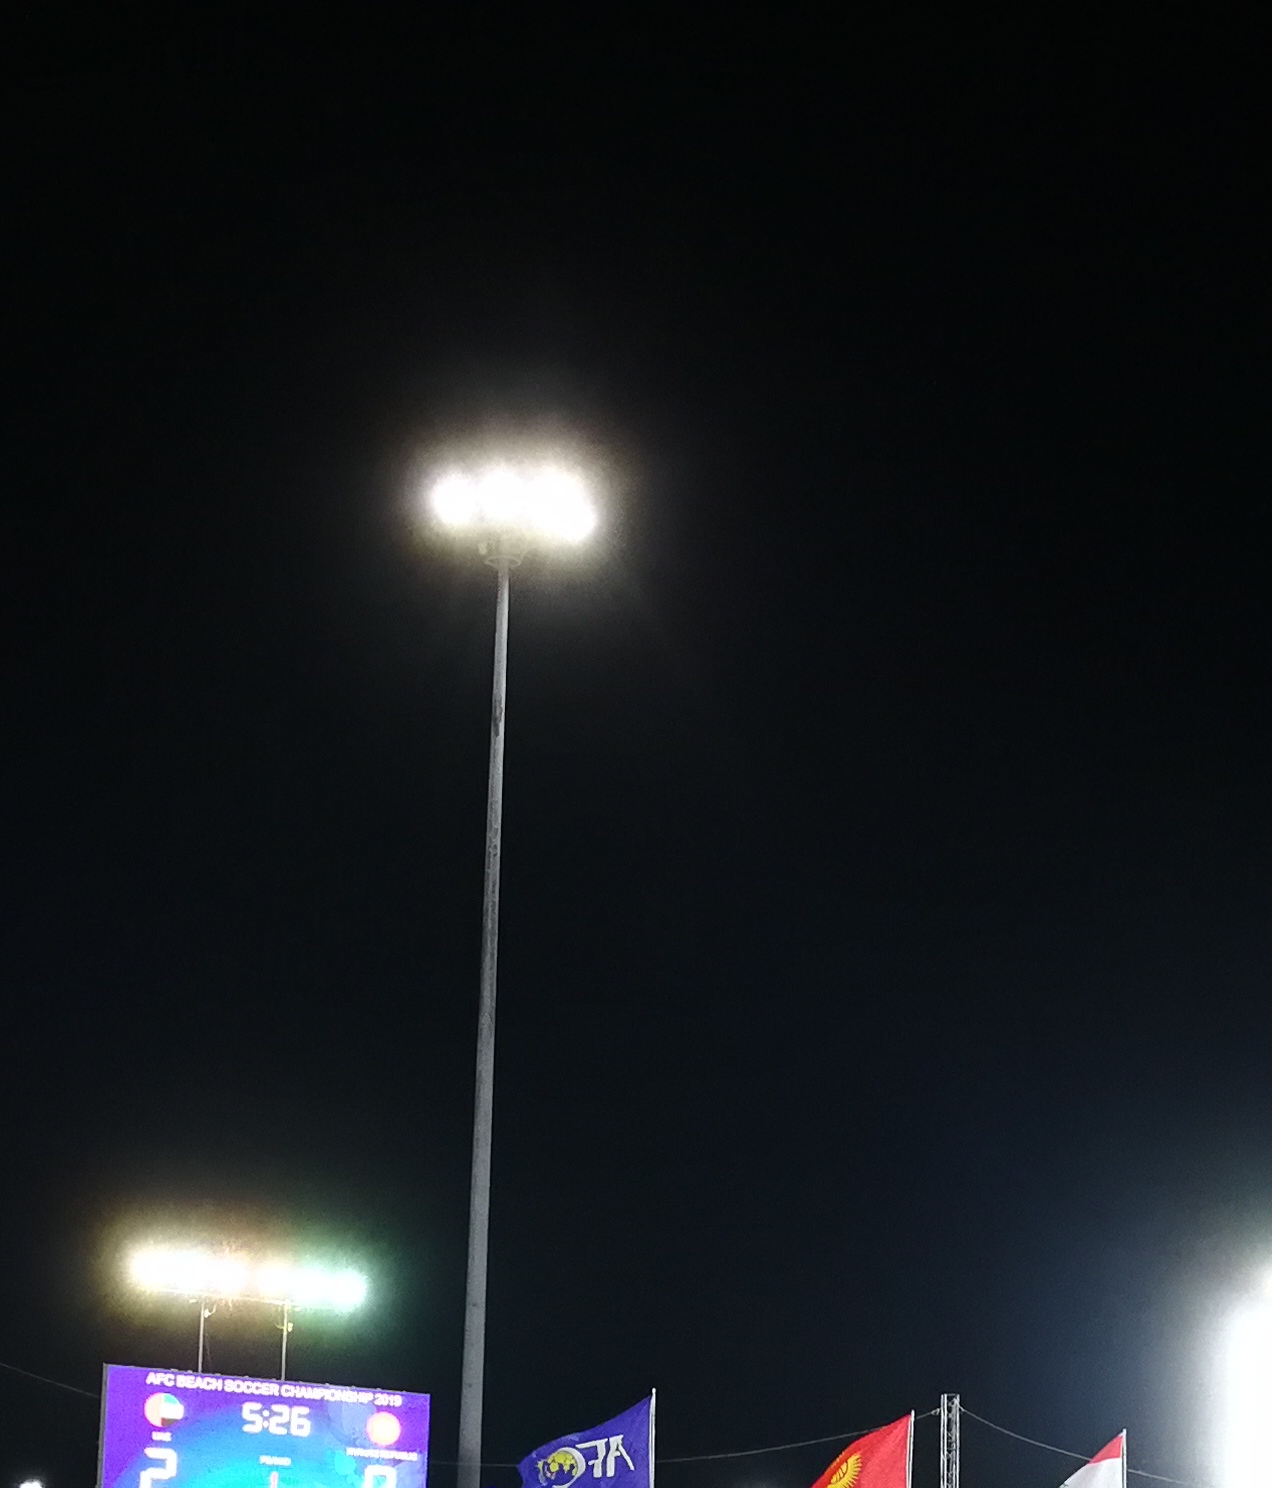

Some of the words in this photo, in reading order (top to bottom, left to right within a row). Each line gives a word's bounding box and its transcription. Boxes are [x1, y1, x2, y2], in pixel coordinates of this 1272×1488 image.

[145, 1372, 175, 1387] AFC
[177, 1375, 223, 1392] BEACH
[224, 1379, 280, 1397] SOCCER
[281, 1384, 374, 1405] CHAMPIONSHIP
[374, 1394, 403, 1407] 2019
[241, 1401, 312, 1438] 5:26
